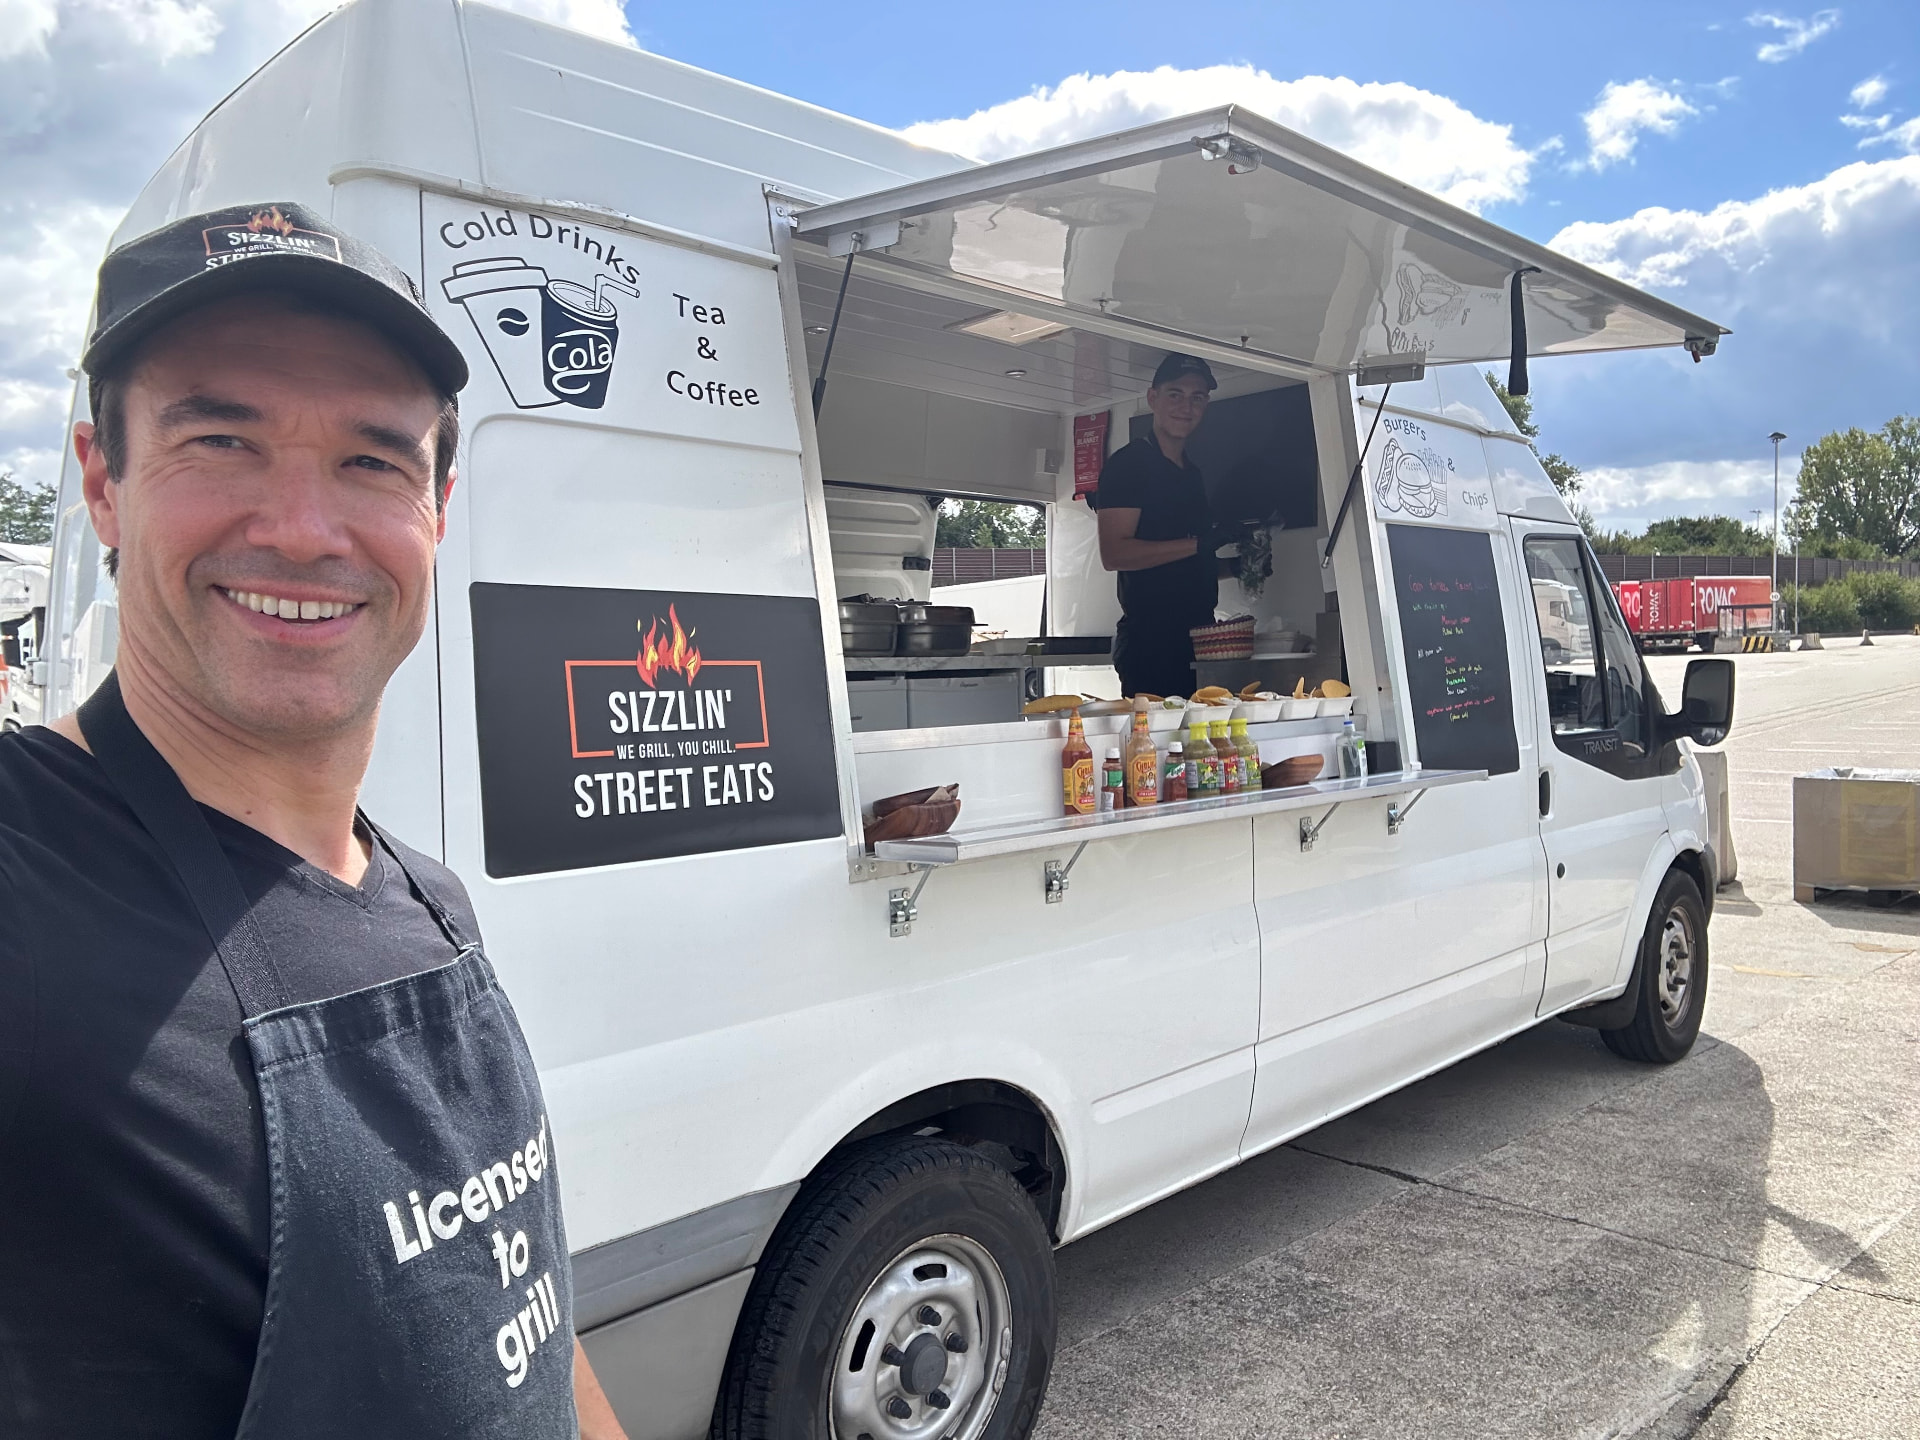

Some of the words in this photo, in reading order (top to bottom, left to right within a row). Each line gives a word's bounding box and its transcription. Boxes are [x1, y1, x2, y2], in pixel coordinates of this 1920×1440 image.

[227, 231, 317, 249] SIZZLIN'
[440, 210, 518, 249] Cold
[529, 214, 641, 285] Drinks
[672, 292, 726, 326] Tea
[547, 337, 614, 374] Cola
[697, 336, 719, 361] &
[666, 370, 760, 407] Coffee
[1384, 418, 1426, 441] Burgers
[1447, 457, 1455, 473] &
[1462, 490, 1489, 510] Chips
[608, 689, 732, 734] SIZZLIN'
[616, 744, 635, 761] WE
[639, 742, 675, 760] GRILL,
[677, 741, 700, 757] YOU
[702, 739, 736, 756] CHILL.
[1584, 738, 1619, 755] TRANSIT
[574, 767, 694, 819] STREET
[702, 762, 774, 807] EATS
[383, 1115, 548, 1264] Licensed
[492, 1230, 529, 1289] to
[496, 1272, 559, 1389] grill
